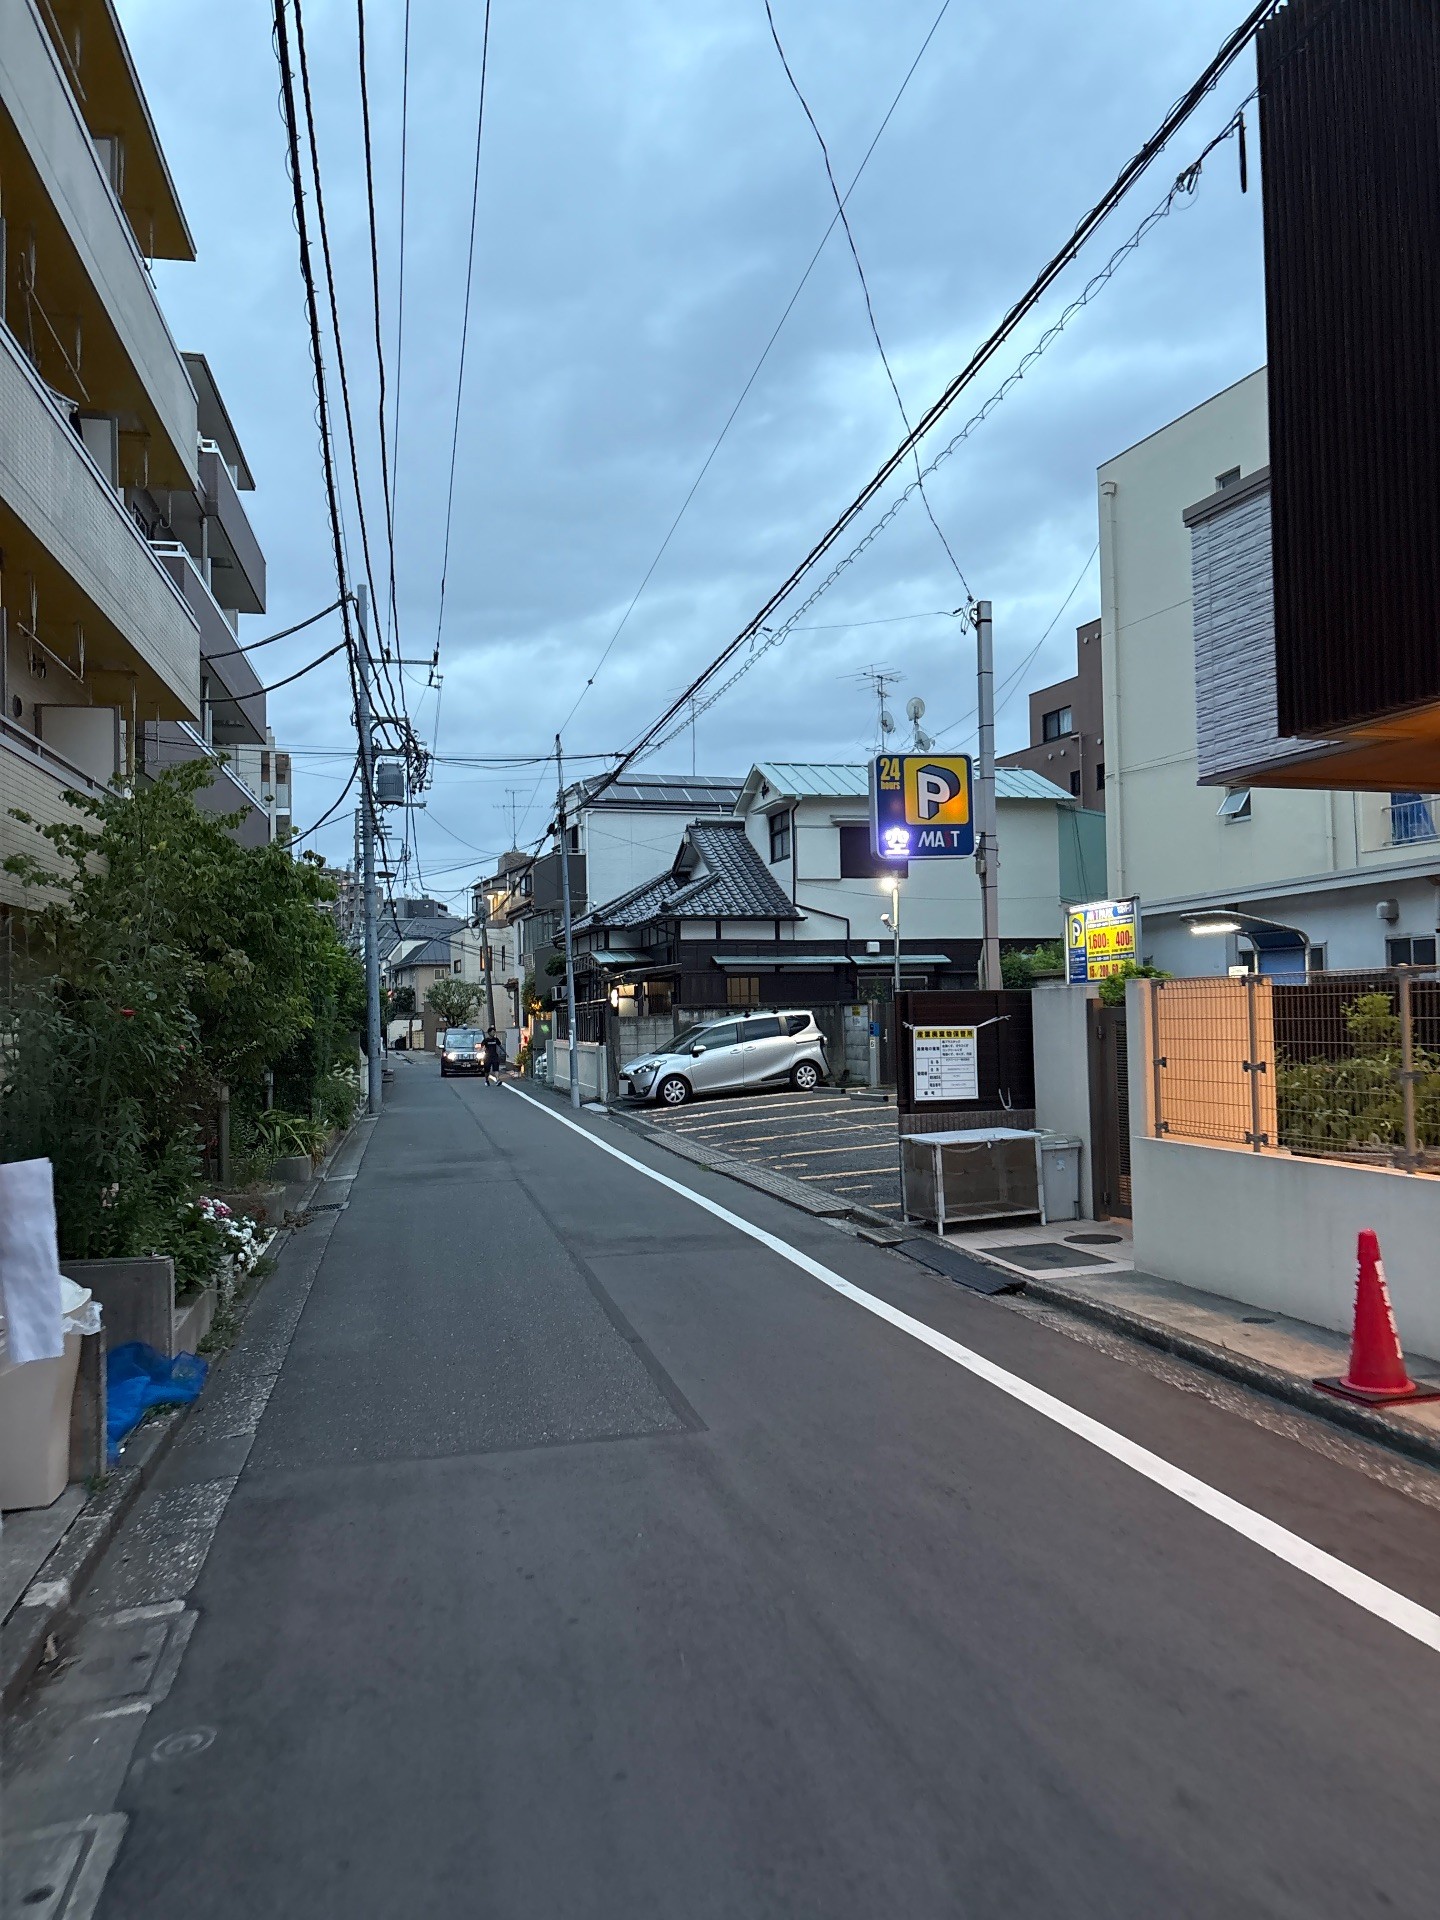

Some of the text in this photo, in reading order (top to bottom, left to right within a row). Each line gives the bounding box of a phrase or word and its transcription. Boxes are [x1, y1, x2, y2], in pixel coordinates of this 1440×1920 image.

[880, 757, 900, 780] 24
[916, 764, 961, 820] P
[918, 830, 960, 848] MAST
